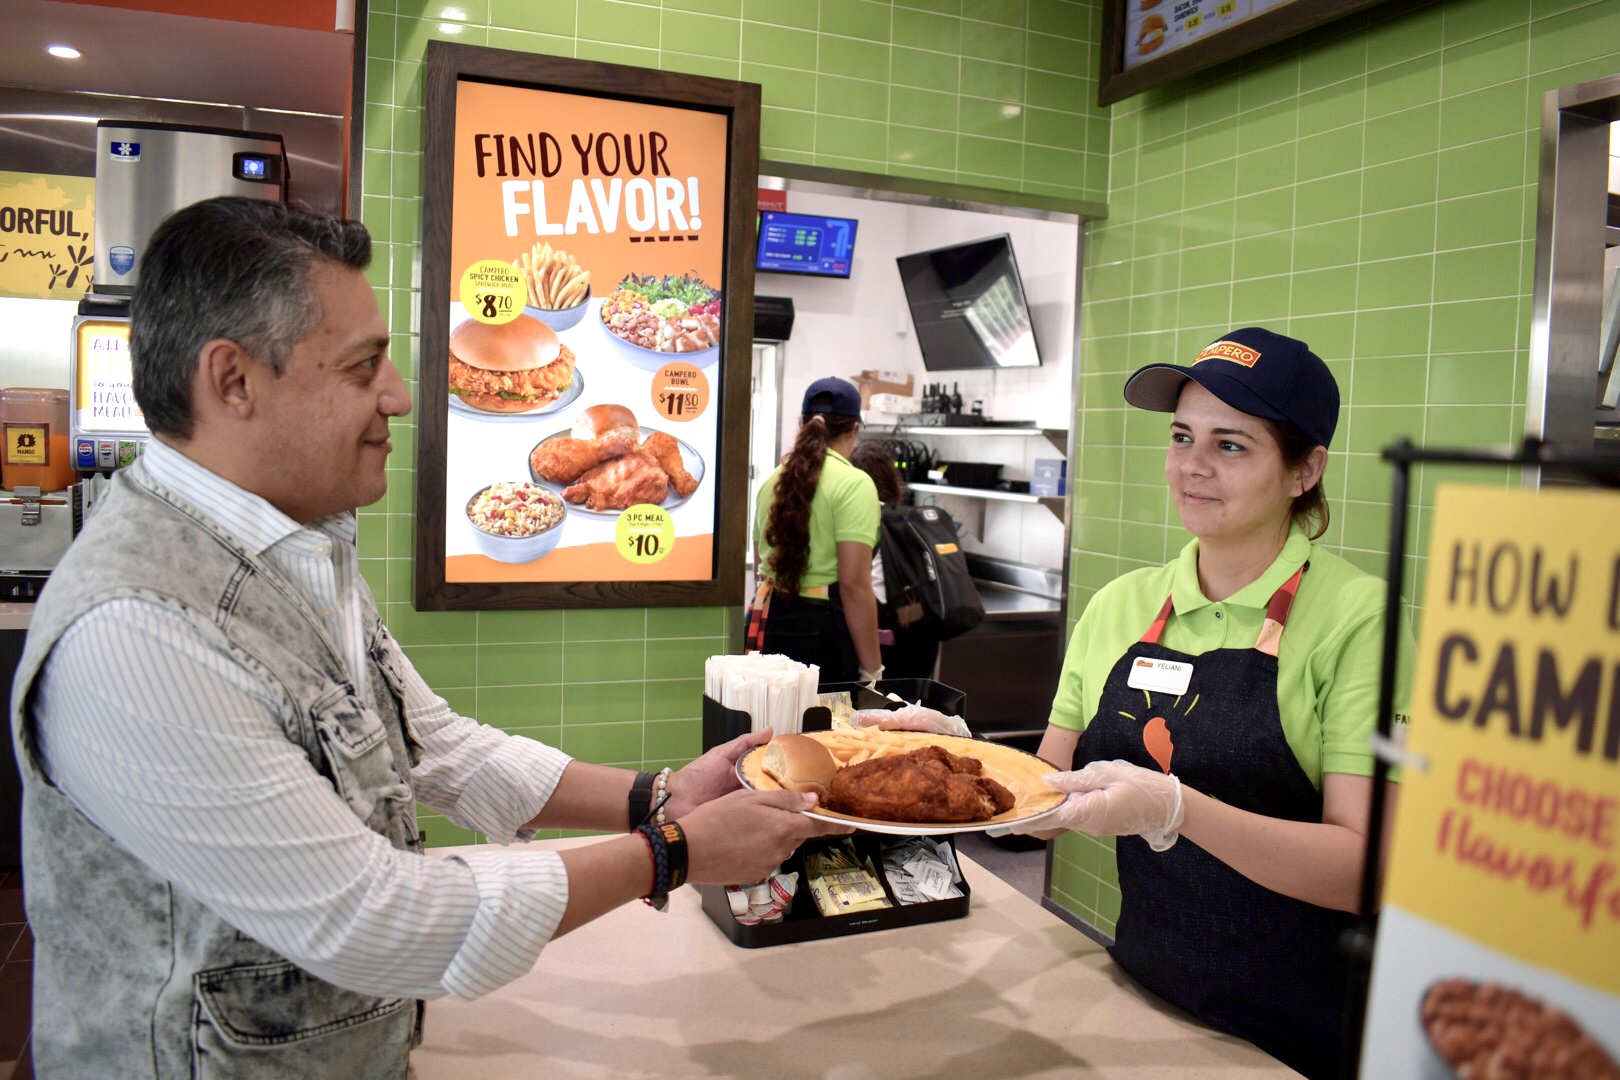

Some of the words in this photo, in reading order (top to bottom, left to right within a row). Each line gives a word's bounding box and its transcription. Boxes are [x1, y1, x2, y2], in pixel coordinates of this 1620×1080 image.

[475, 132, 562, 177] FIND
[571, 131, 671, 176] YOUR
[502, 176, 702, 236] FLAVOR!
[480, 266, 509, 275] CAMPERO
[469, 272, 489, 281] SPICY
[490, 274, 519, 283] CHICKEN
[474, 280, 500, 288] SANDWICH
[664, 370, 697, 379] CAMPERO
[671, 378, 689, 386] BOWL
[645, 514, 664, 522] MEAL
[1447, 539, 1580, 620] HOW
[1456, 756, 1619, 851] CHOOSE
